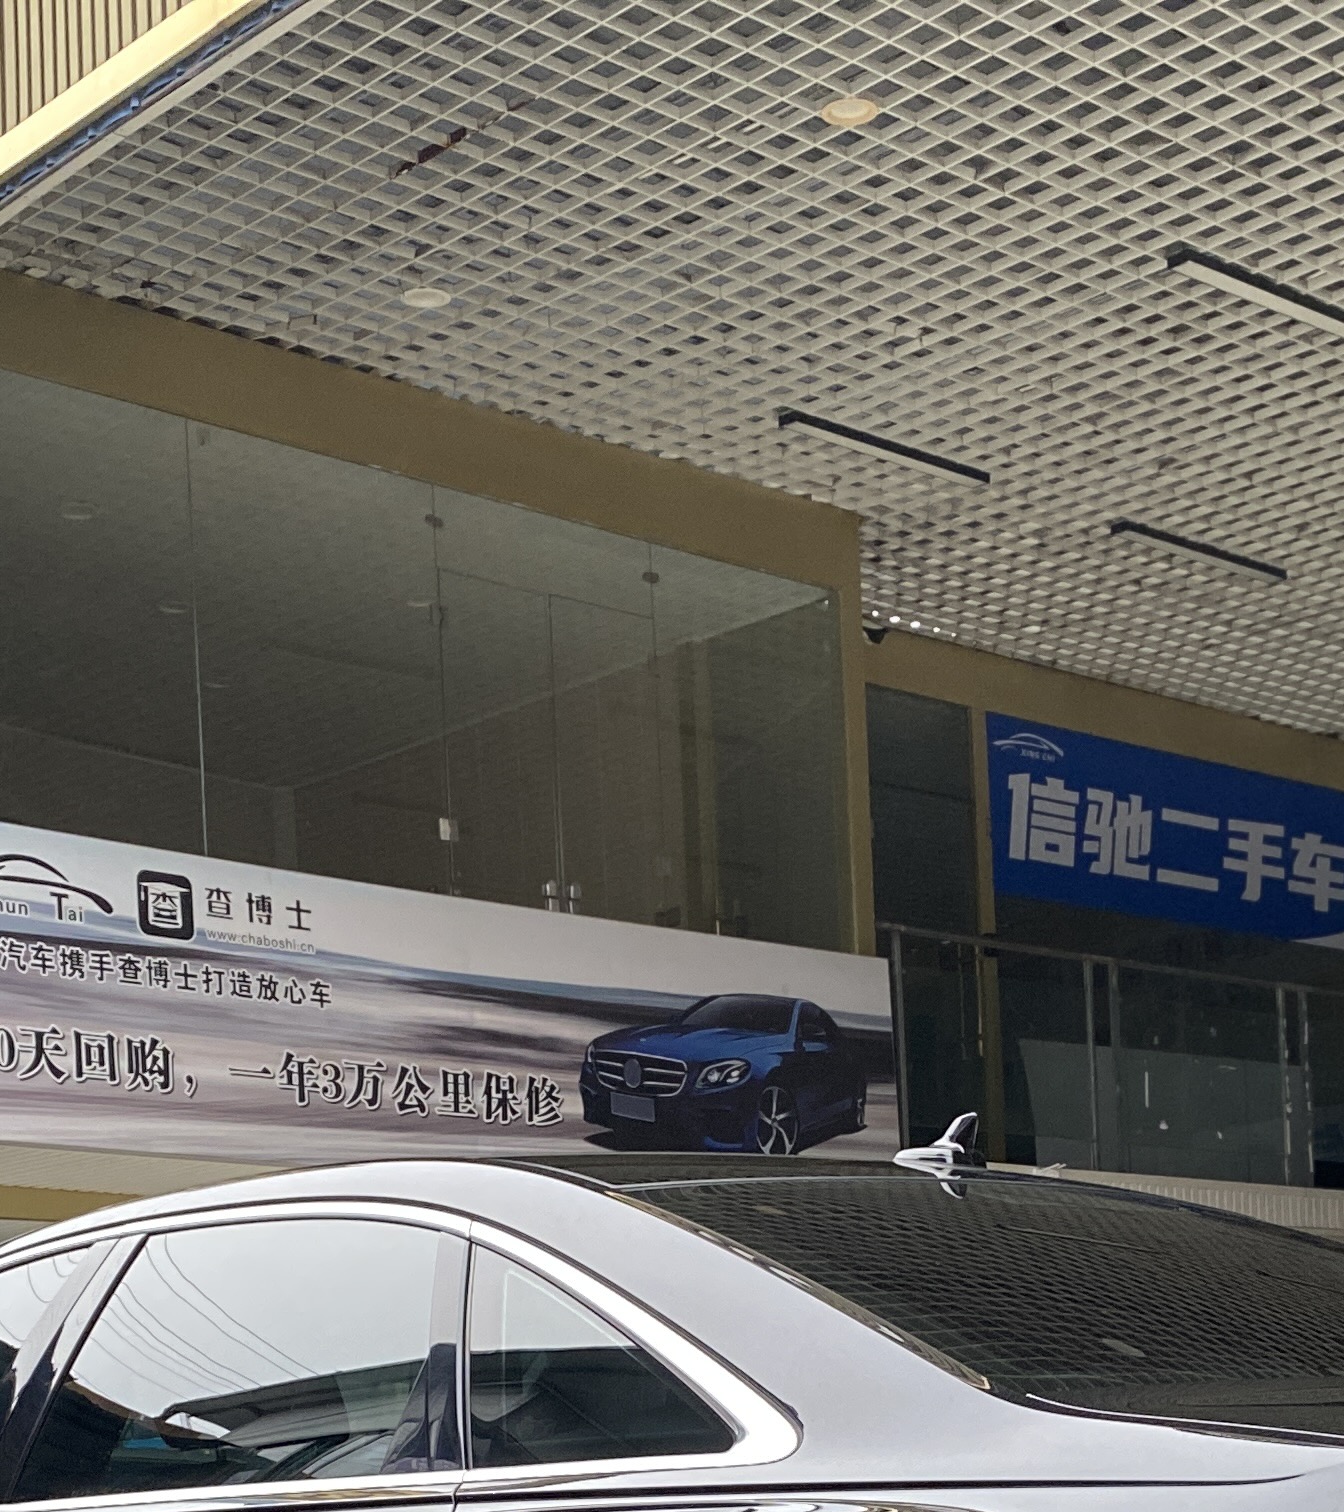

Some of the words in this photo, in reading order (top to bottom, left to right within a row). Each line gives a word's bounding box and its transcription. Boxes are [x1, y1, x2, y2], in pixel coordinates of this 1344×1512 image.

[49, 891, 84, 922] Tai
[204, 887, 312, 932] 查博士
[207, 929, 315, 953] www.chaboshi.cn
